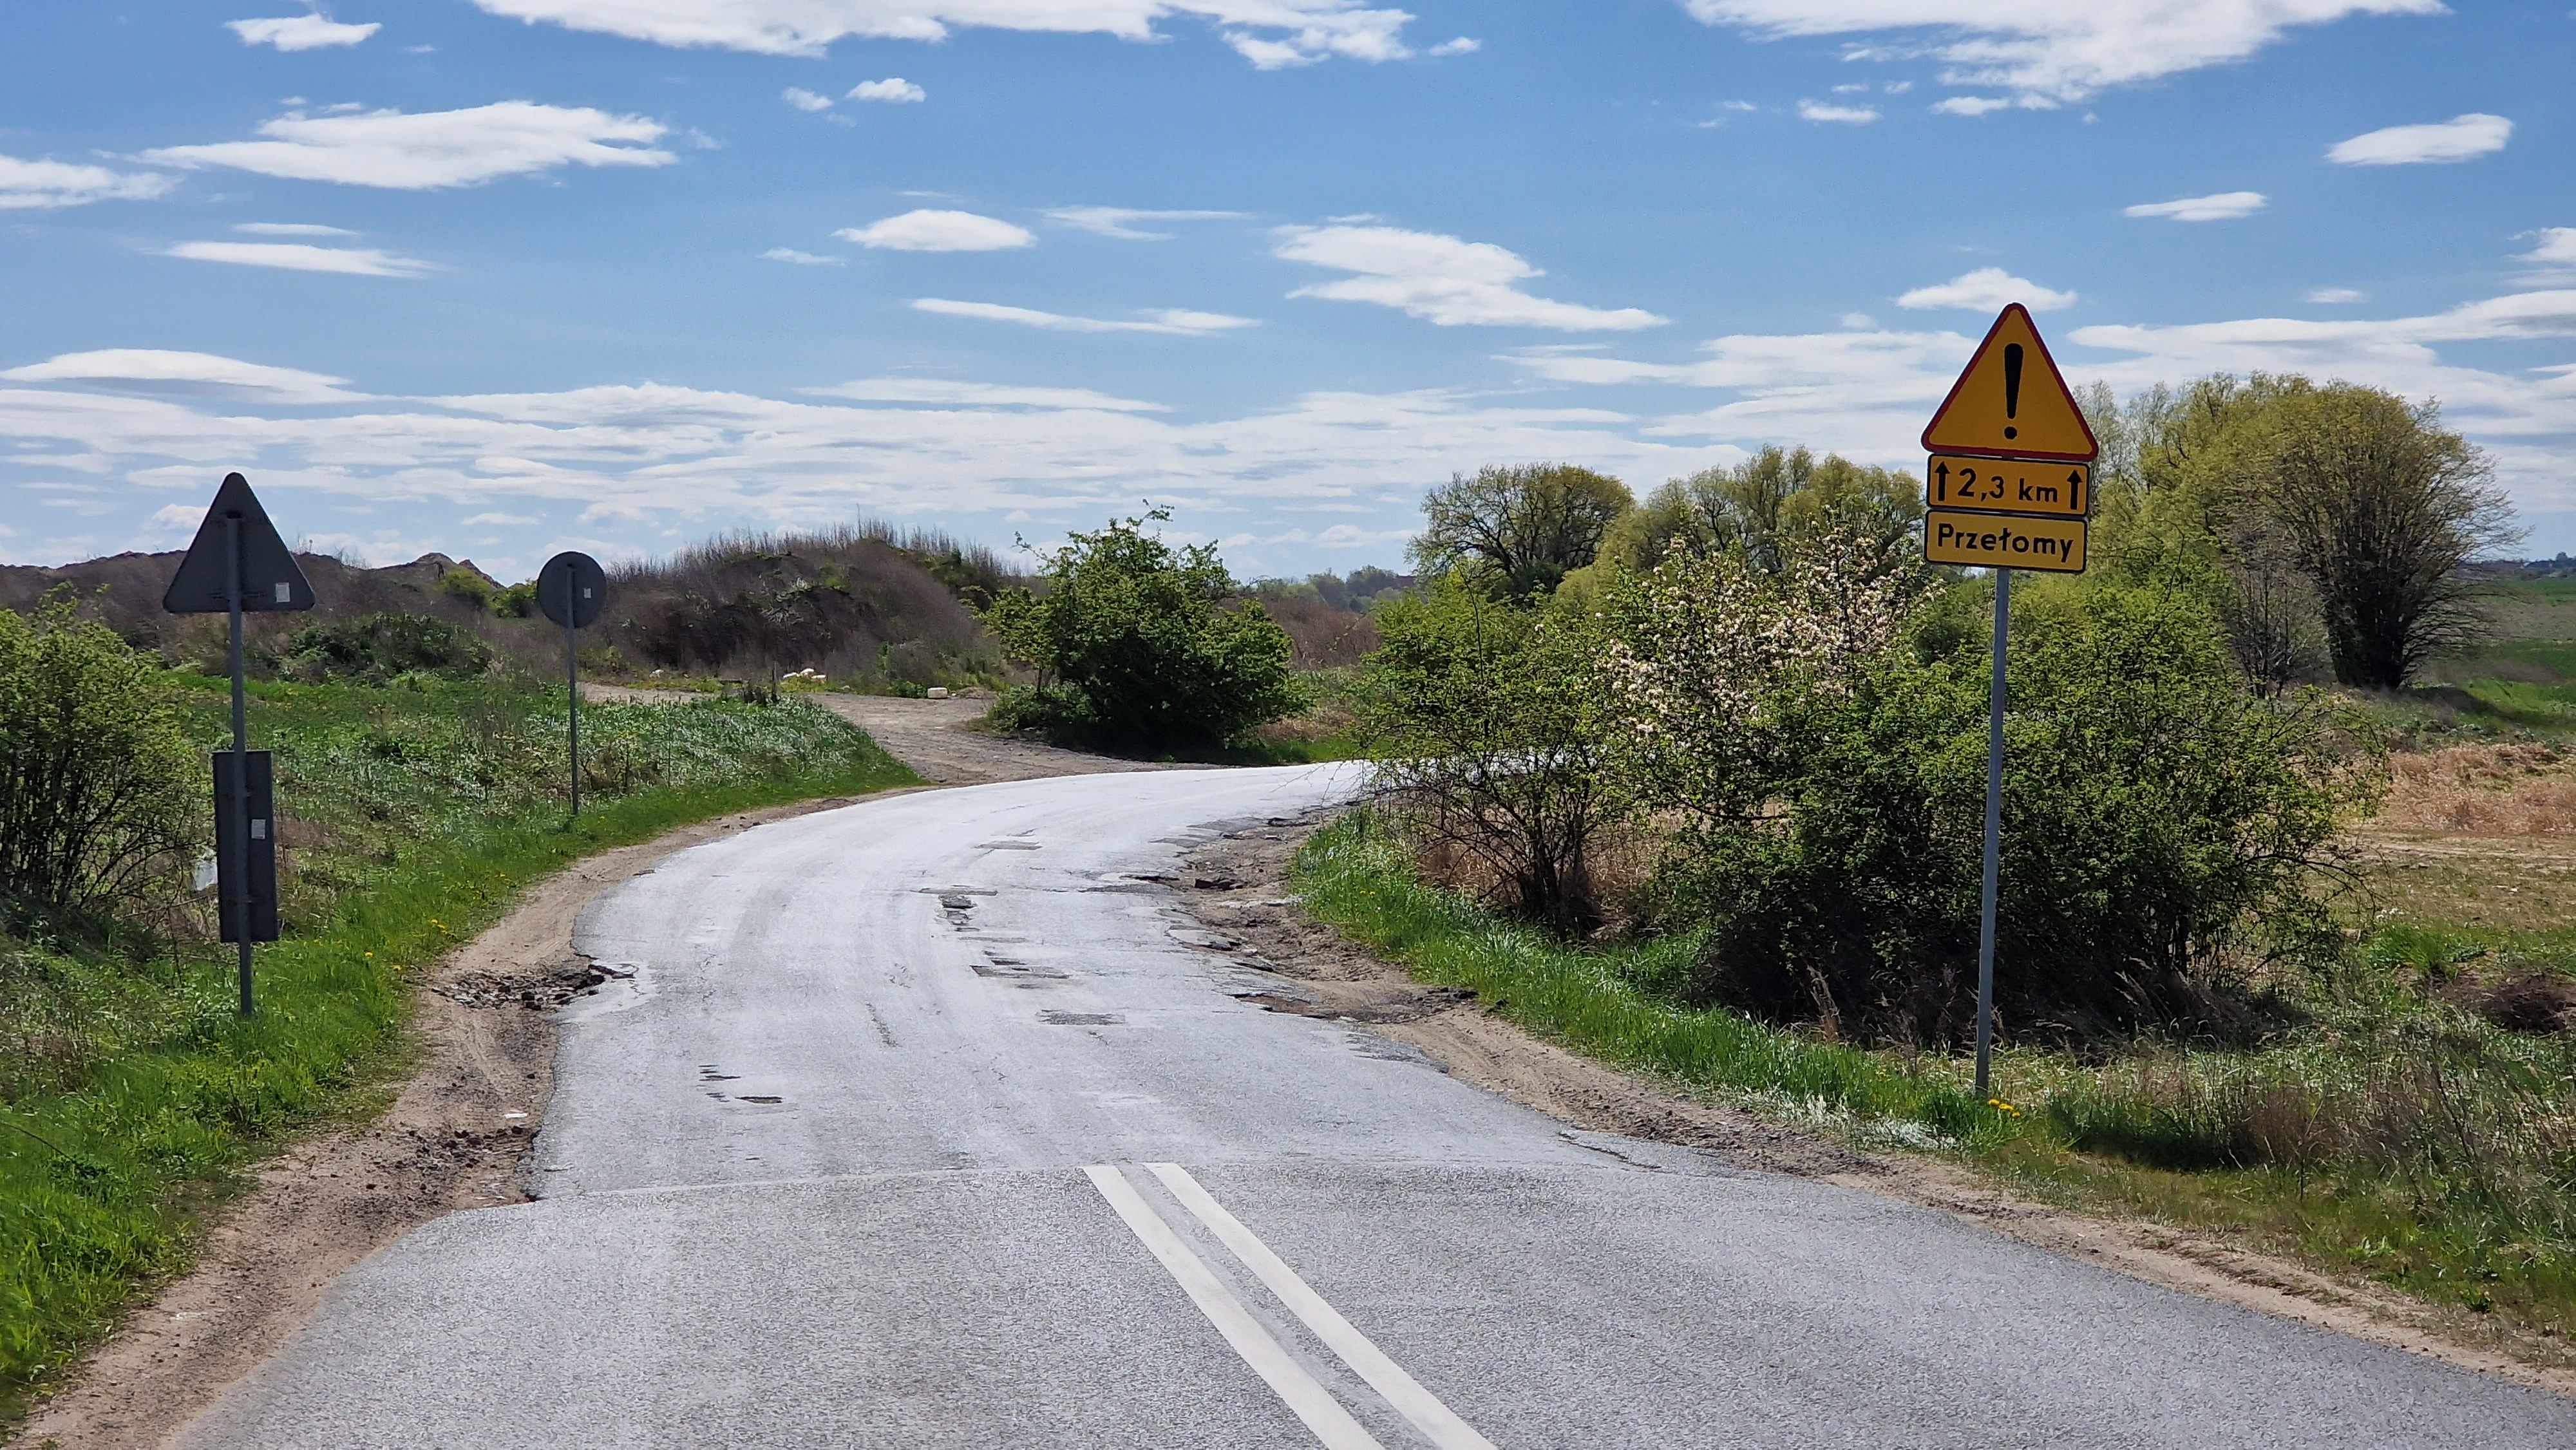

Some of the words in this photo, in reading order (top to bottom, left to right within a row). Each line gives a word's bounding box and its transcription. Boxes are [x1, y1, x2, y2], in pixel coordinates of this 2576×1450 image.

[1958, 468, 2004, 502] 2,3
[2018, 478, 2058, 503] km
[1938, 523, 2074, 563] Przełomy
